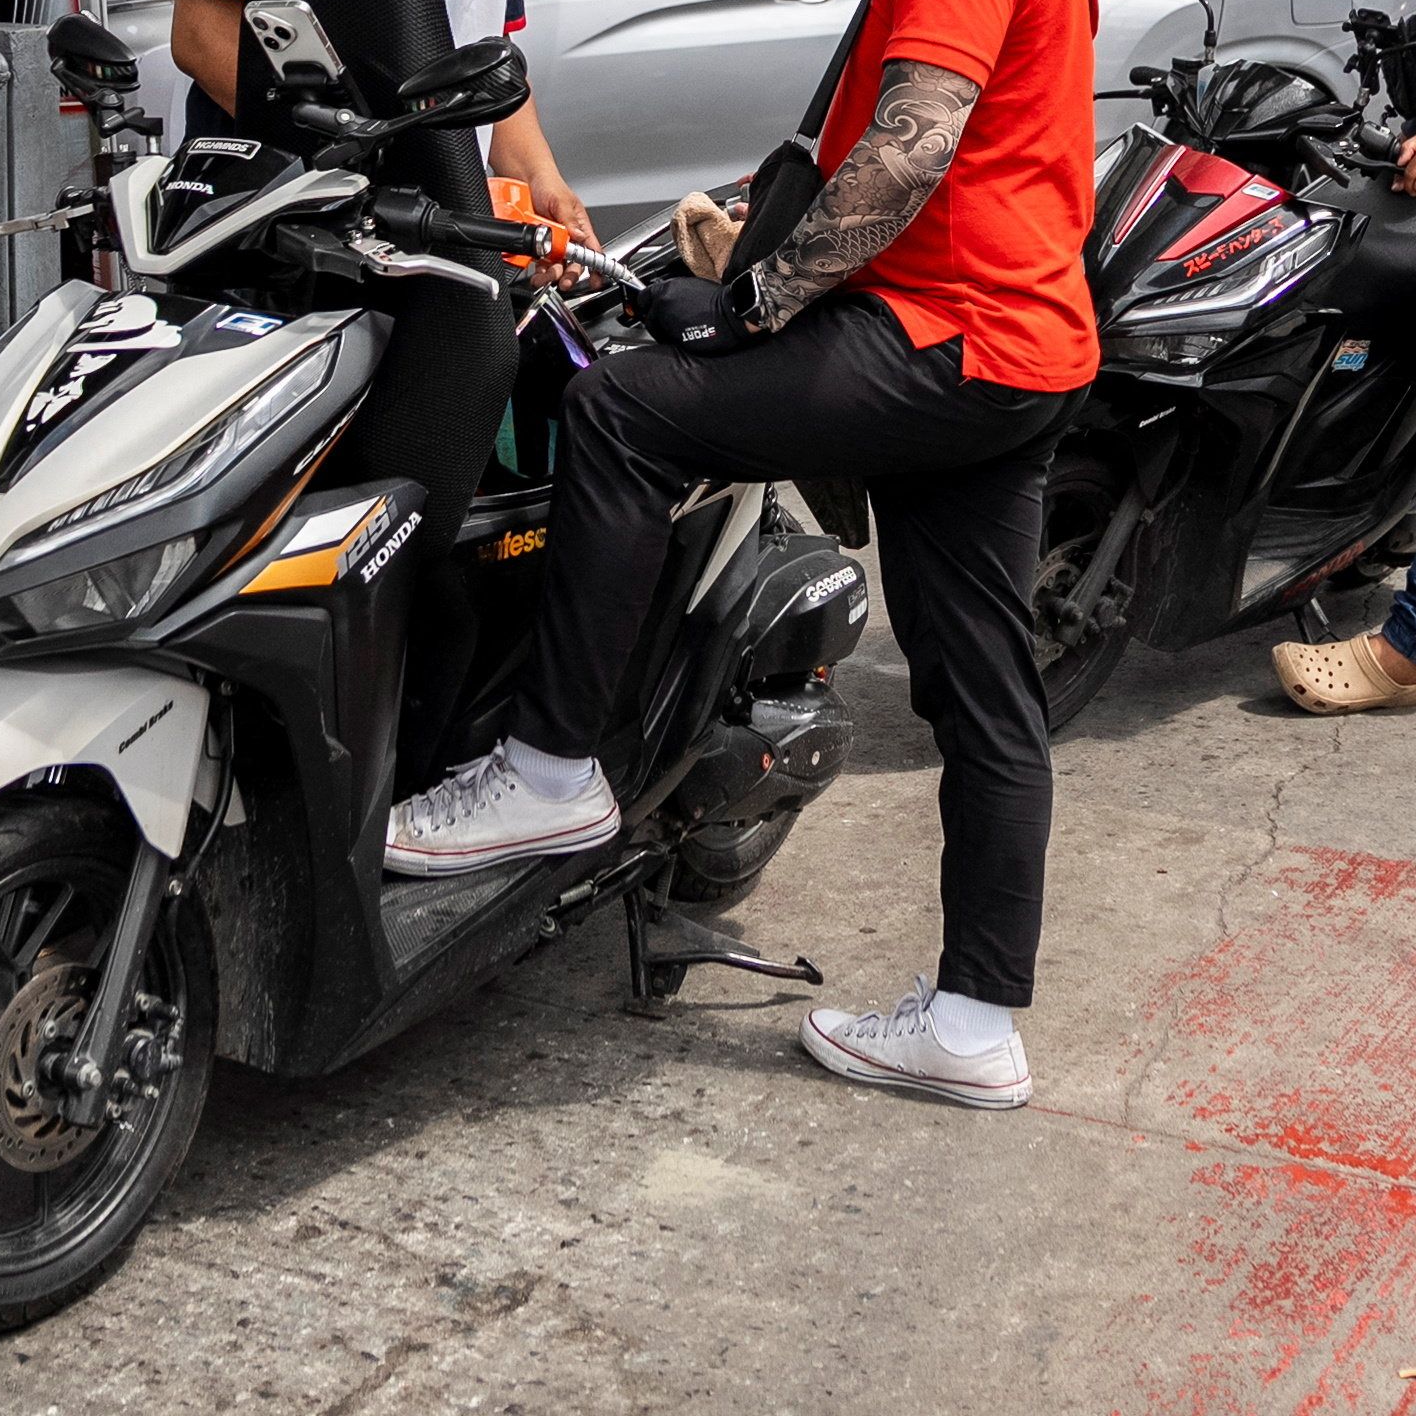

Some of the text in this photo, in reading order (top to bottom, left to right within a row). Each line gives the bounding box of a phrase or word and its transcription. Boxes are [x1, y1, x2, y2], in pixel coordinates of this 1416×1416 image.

[166, 180, 214, 195] HONDA
[360, 511, 422, 584] HONDA
[119, 720, 148, 755] Combi
